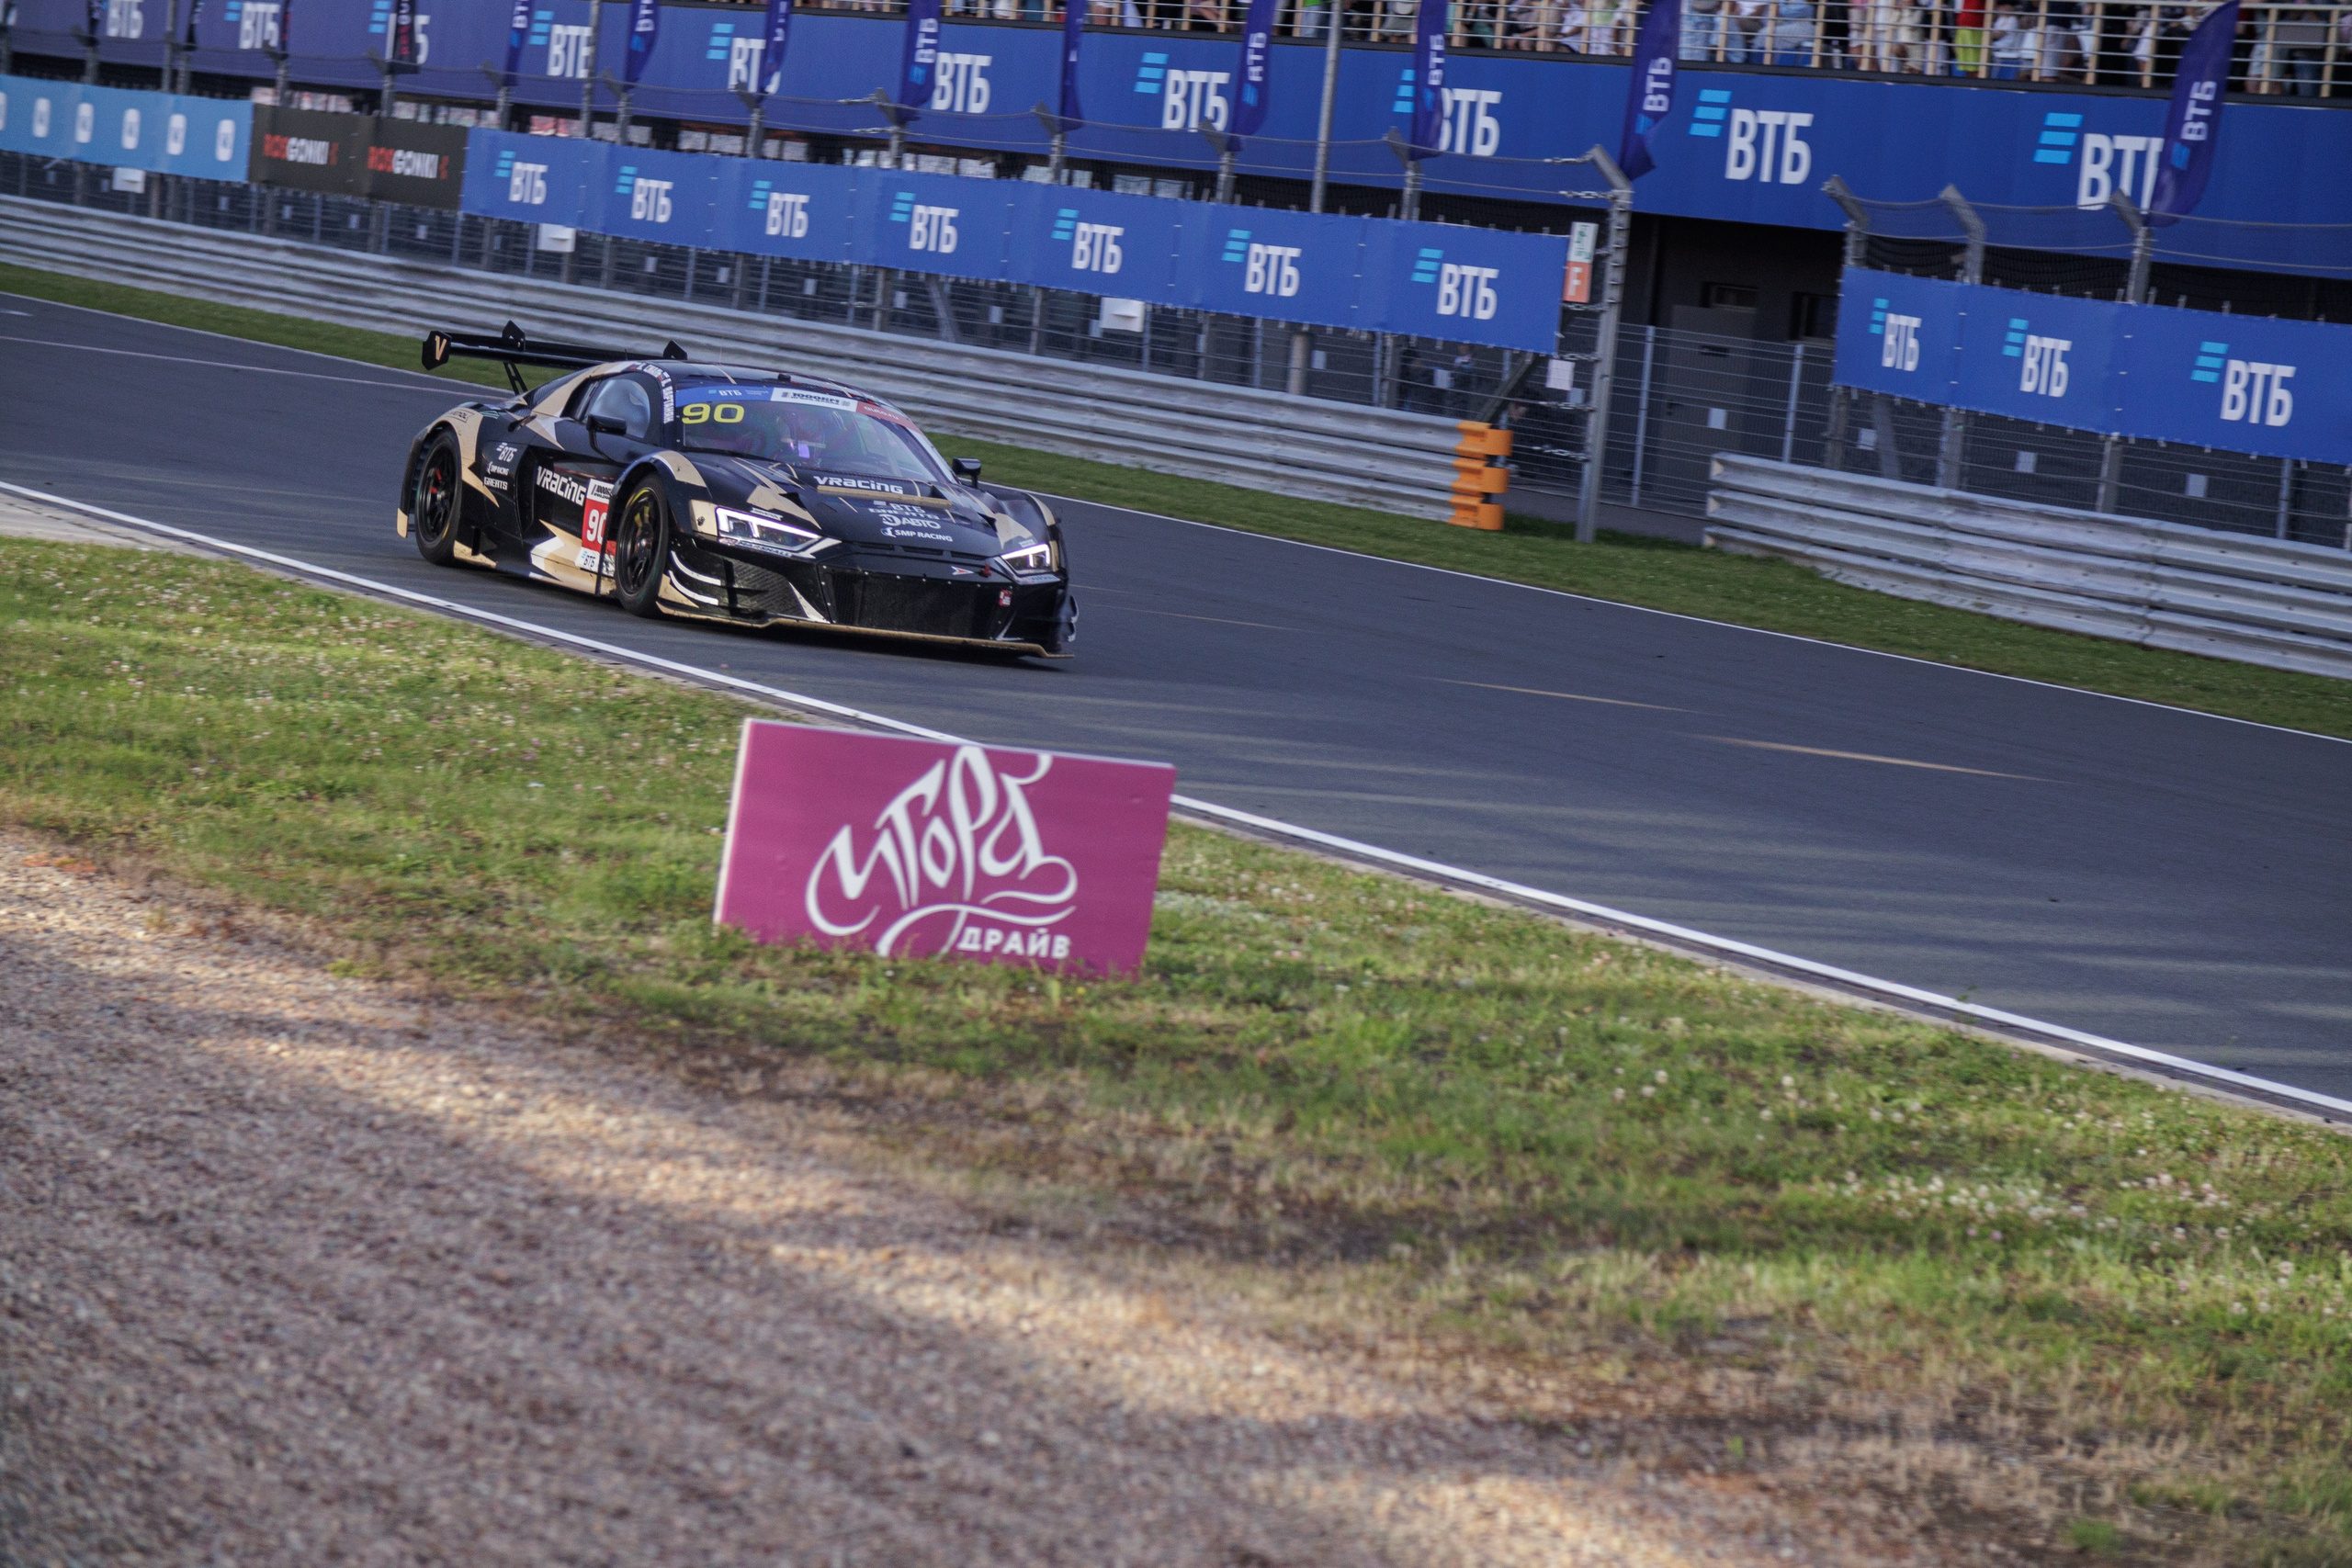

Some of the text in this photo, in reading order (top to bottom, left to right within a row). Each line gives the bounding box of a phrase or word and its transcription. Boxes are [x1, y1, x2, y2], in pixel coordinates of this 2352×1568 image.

[512, 0, 530, 28] ВТ
[931, 51, 992, 114] ВТБ
[1162, 69, 1230, 132] ВТБ
[1643, 56, 1672, 112] ВТБ
[2180, 81, 2217, 141] ВТБ
[1725, 108, 1814, 185] ВТБ
[509, 162, 548, 205] ВТБ
[631, 178, 673, 223] ВТБ
[765, 193, 809, 238] ВТБ
[910, 205, 959, 254] ВТБ
[1071, 222, 1125, 274] ВТБ
[1245, 243, 1302, 297] ВТБ
[1437, 264, 1499, 321] ВТБ
[435, 334, 447, 361] V
[1882, 313, 1922, 372] ВТБ
[2019, 335, 2072, 398] ВТБ
[682, 402, 745, 424] 90
[2220, 359, 2296, 427] ВТБ
[499, 446, 517, 462] ВТБ
[889, 502, 926, 513] ВТБ
[895, 529, 954, 543] SMP RACING
[583, 555, 596, 568] ВТБ
[957, 926, 1070, 959] ДРАЙВ
